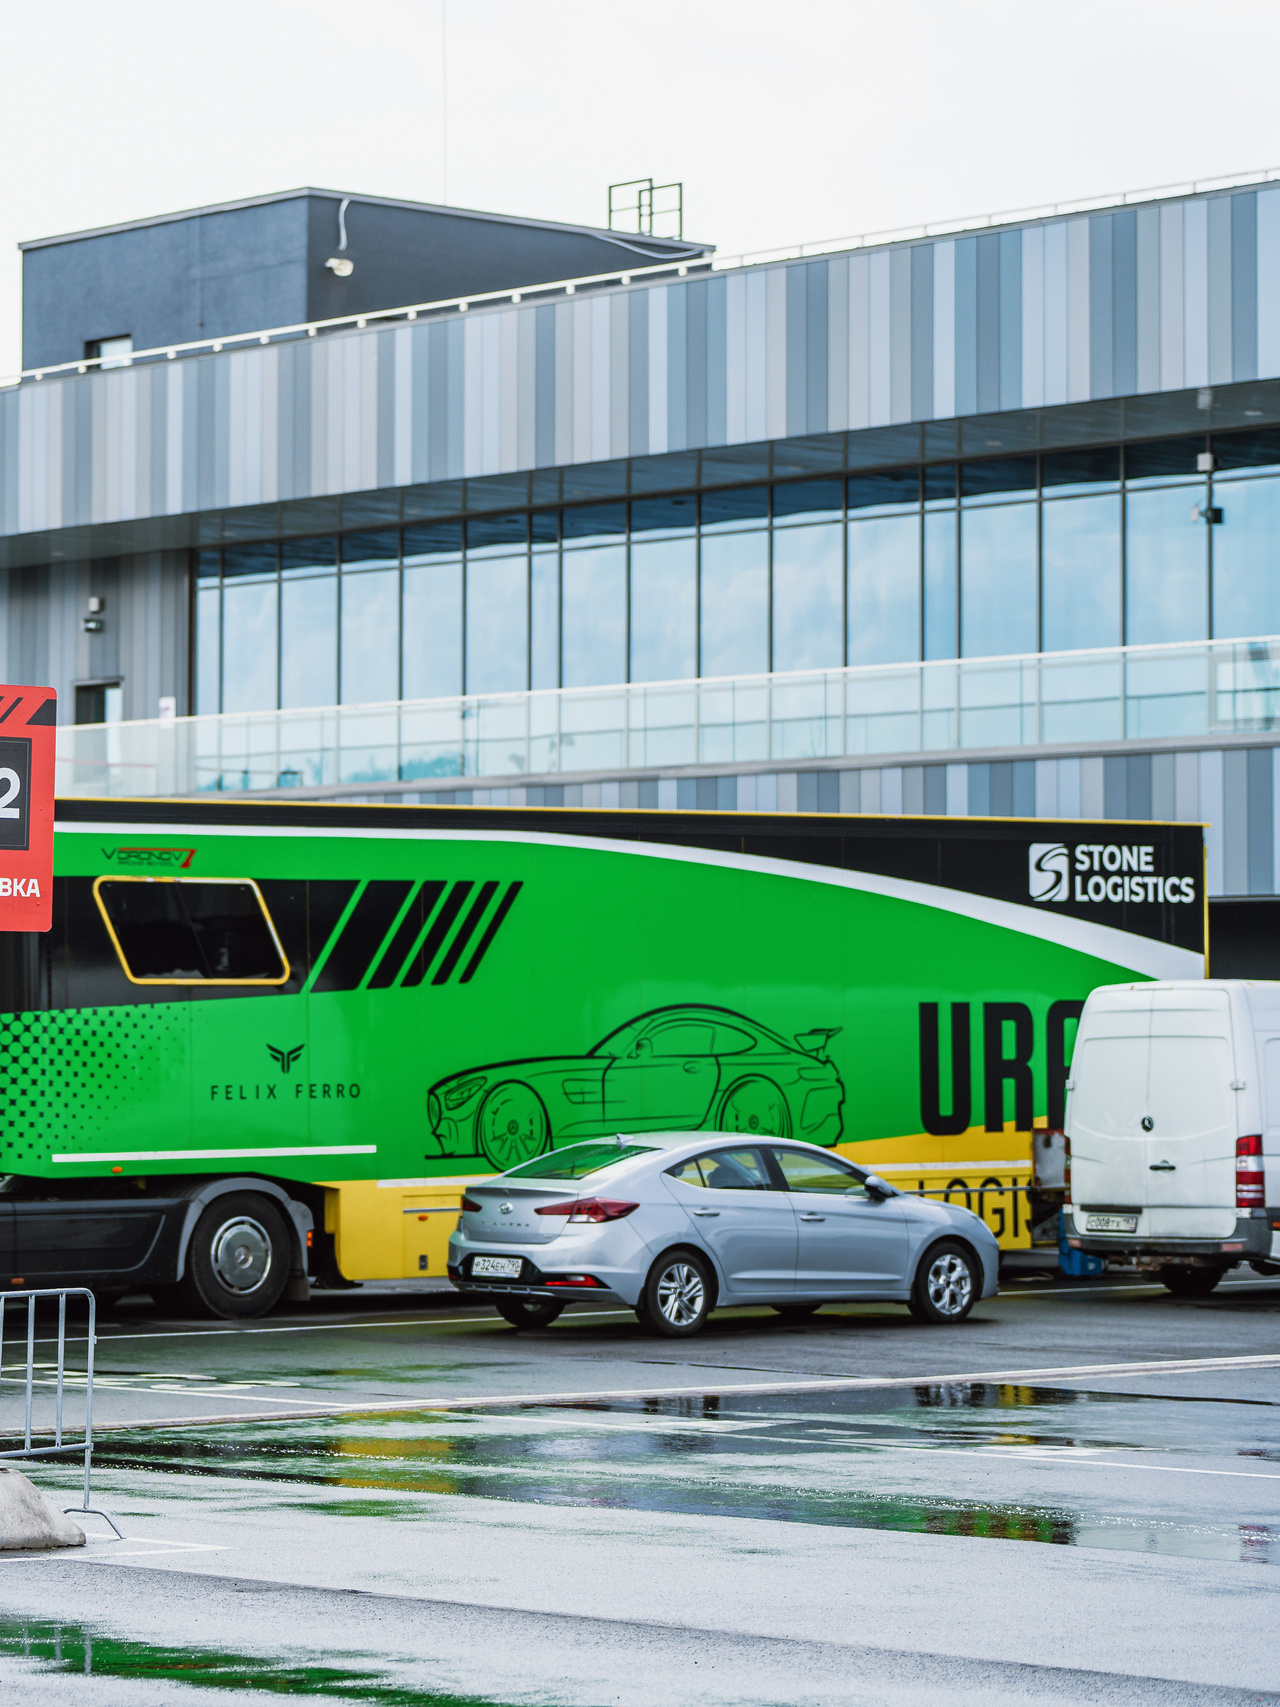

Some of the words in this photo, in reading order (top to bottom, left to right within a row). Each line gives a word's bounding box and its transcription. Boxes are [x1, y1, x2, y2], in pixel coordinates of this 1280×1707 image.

[1074, 844, 1155, 872] STONE
[1074, 875, 1196, 904] LOGISTICS
[211, 1084, 277, 1100] FELIX
[295, 1083, 361, 1099] FERRO
